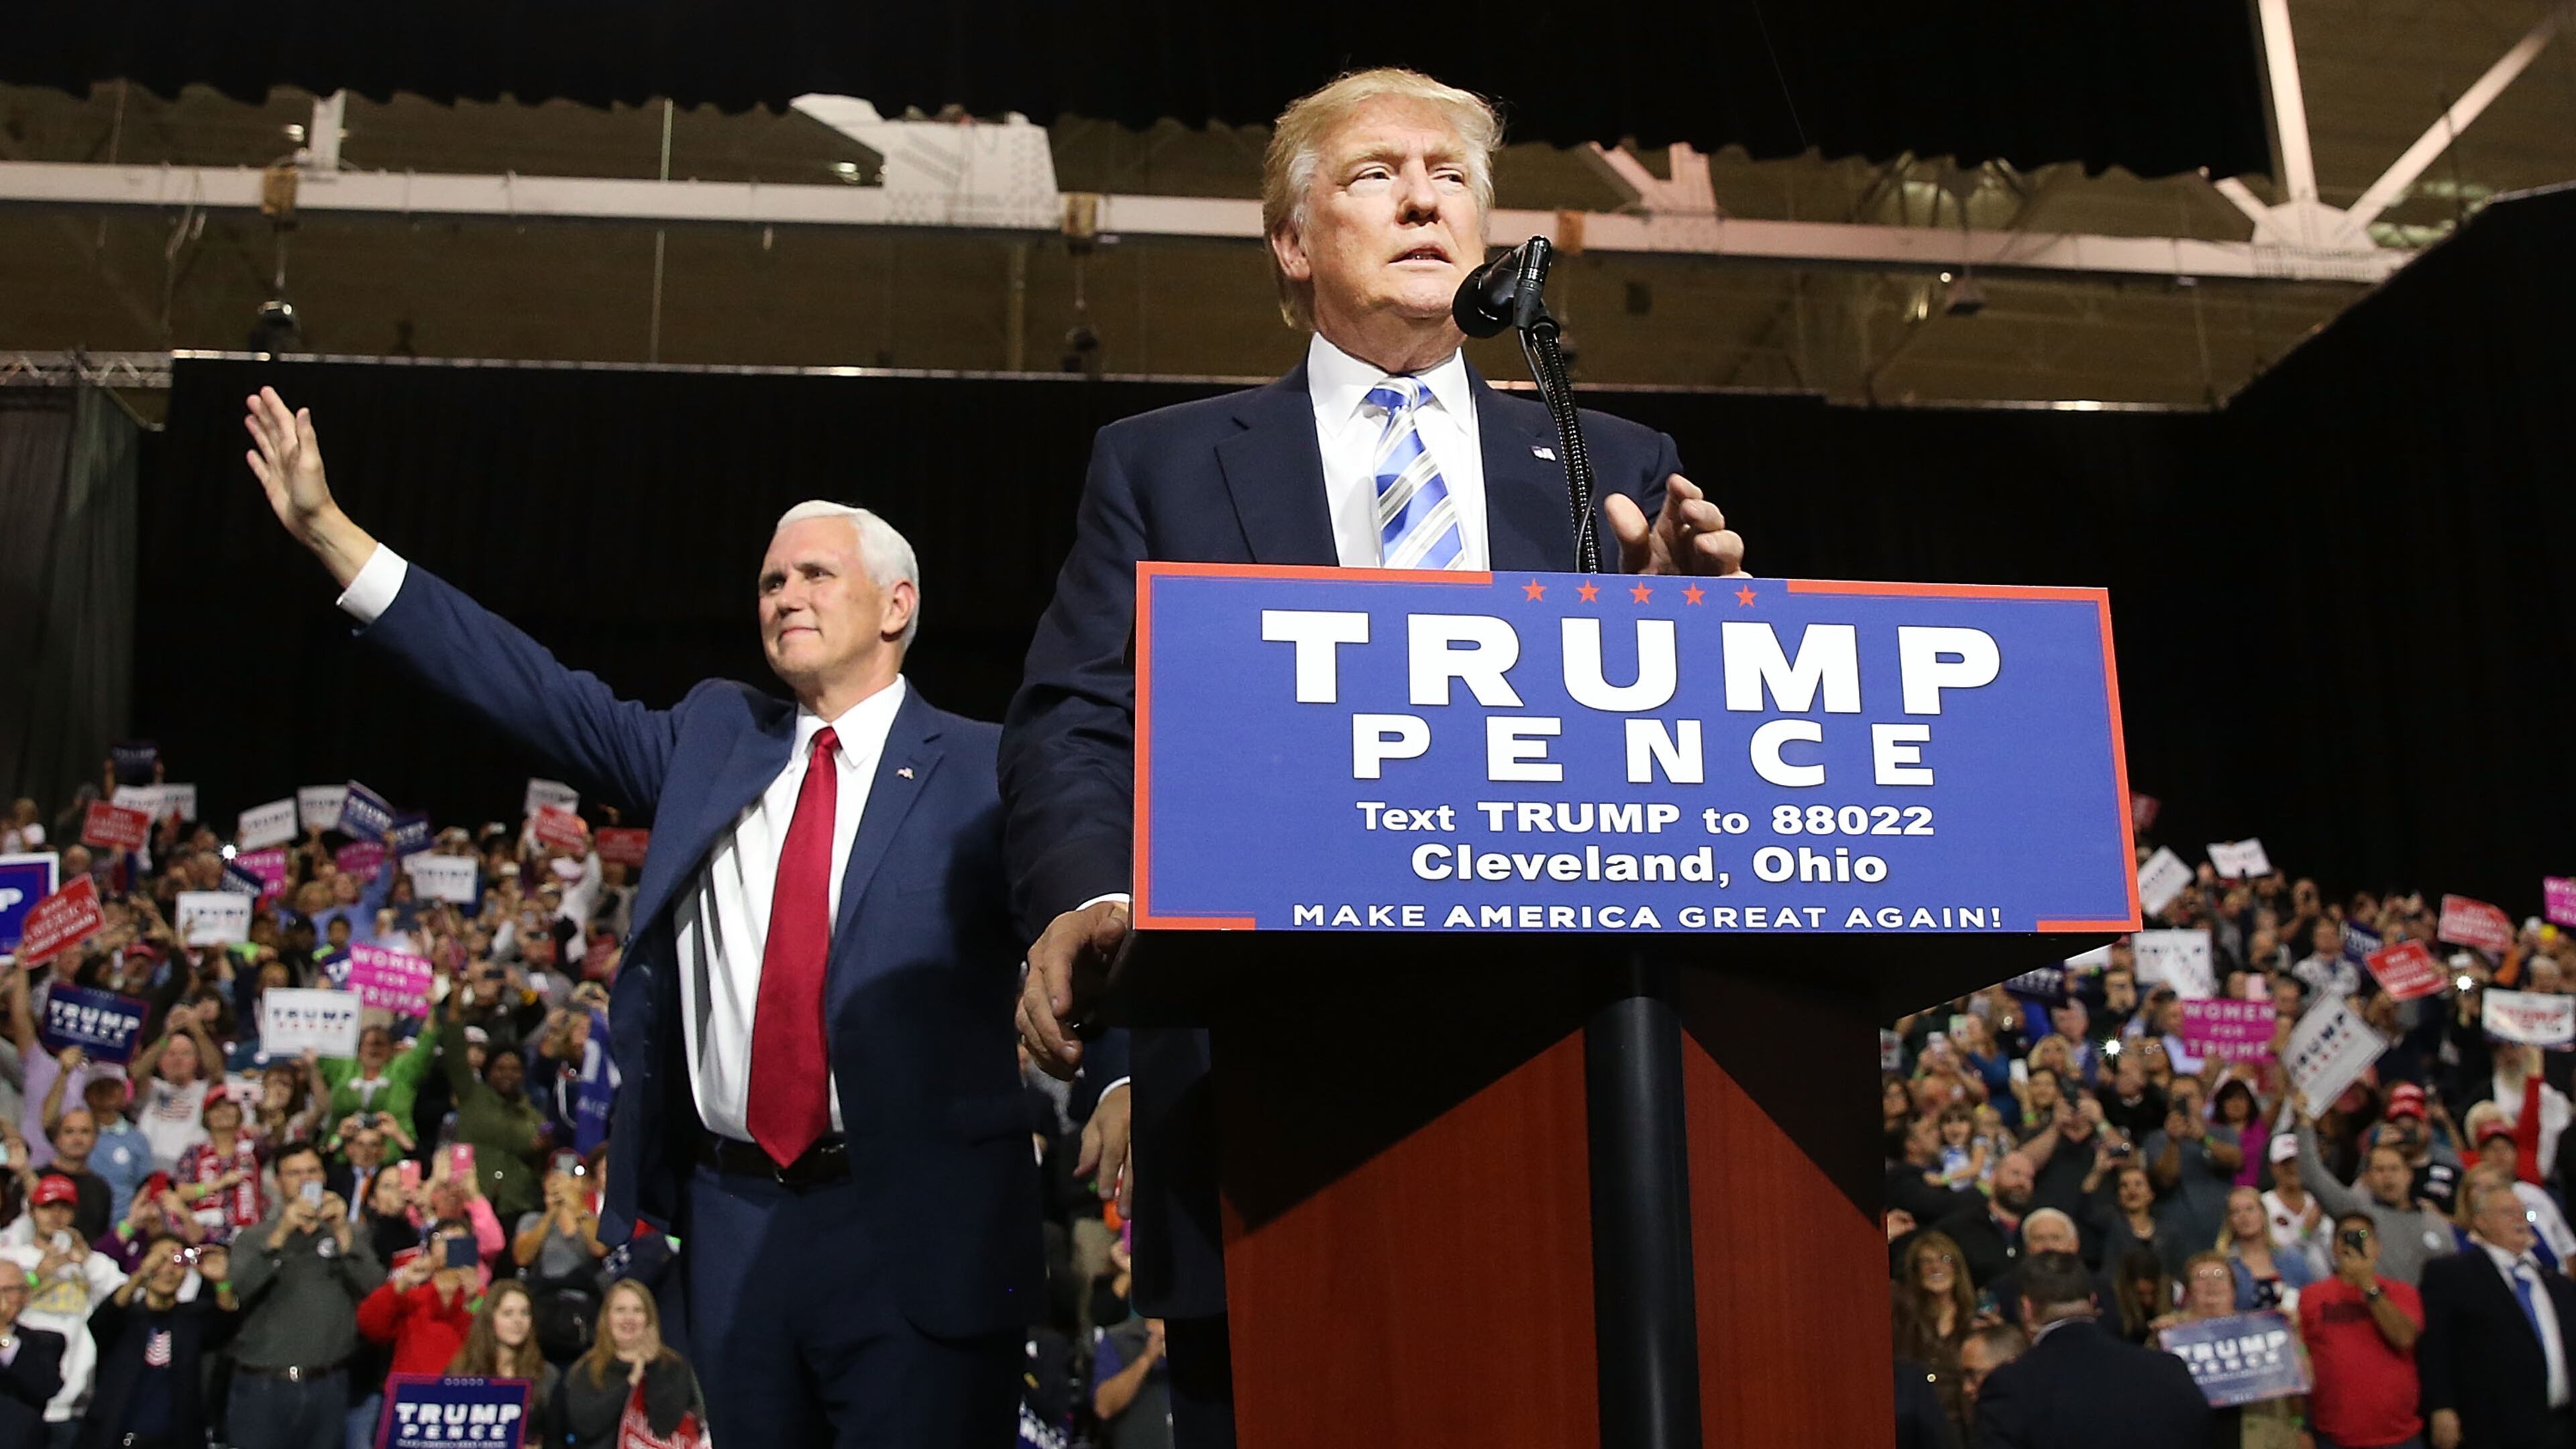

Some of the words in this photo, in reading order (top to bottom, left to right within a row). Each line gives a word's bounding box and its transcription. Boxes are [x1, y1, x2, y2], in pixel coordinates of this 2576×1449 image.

[1261, 609, 2000, 715] TRUMP
[1352, 713, 1934, 788] PENCE
[1356, 801, 1456, 832] Text
[1477, 801, 1680, 833] TRUMP
[1702, 807, 1750, 835] to
[1772, 804, 1935, 836] 88022
[1411, 843, 1729, 889] Cleveland,
[1752, 846, 1888, 883] Ohio
[1293, 904, 1426, 927] MAKE
[1443, 905, 1662, 929] AMERICA
[1678, 906, 1827, 928] GREAT
[1844, 907, 2001, 928] AGAIN!
[351, 945, 433, 977] WOMEN
[48, 998, 141, 1030] TRUMP
[2184, 1002, 2276, 1022] WOMEN
[394, 1402, 522, 1425] TRUMP
[401, 1423, 507, 1440] PENCE
